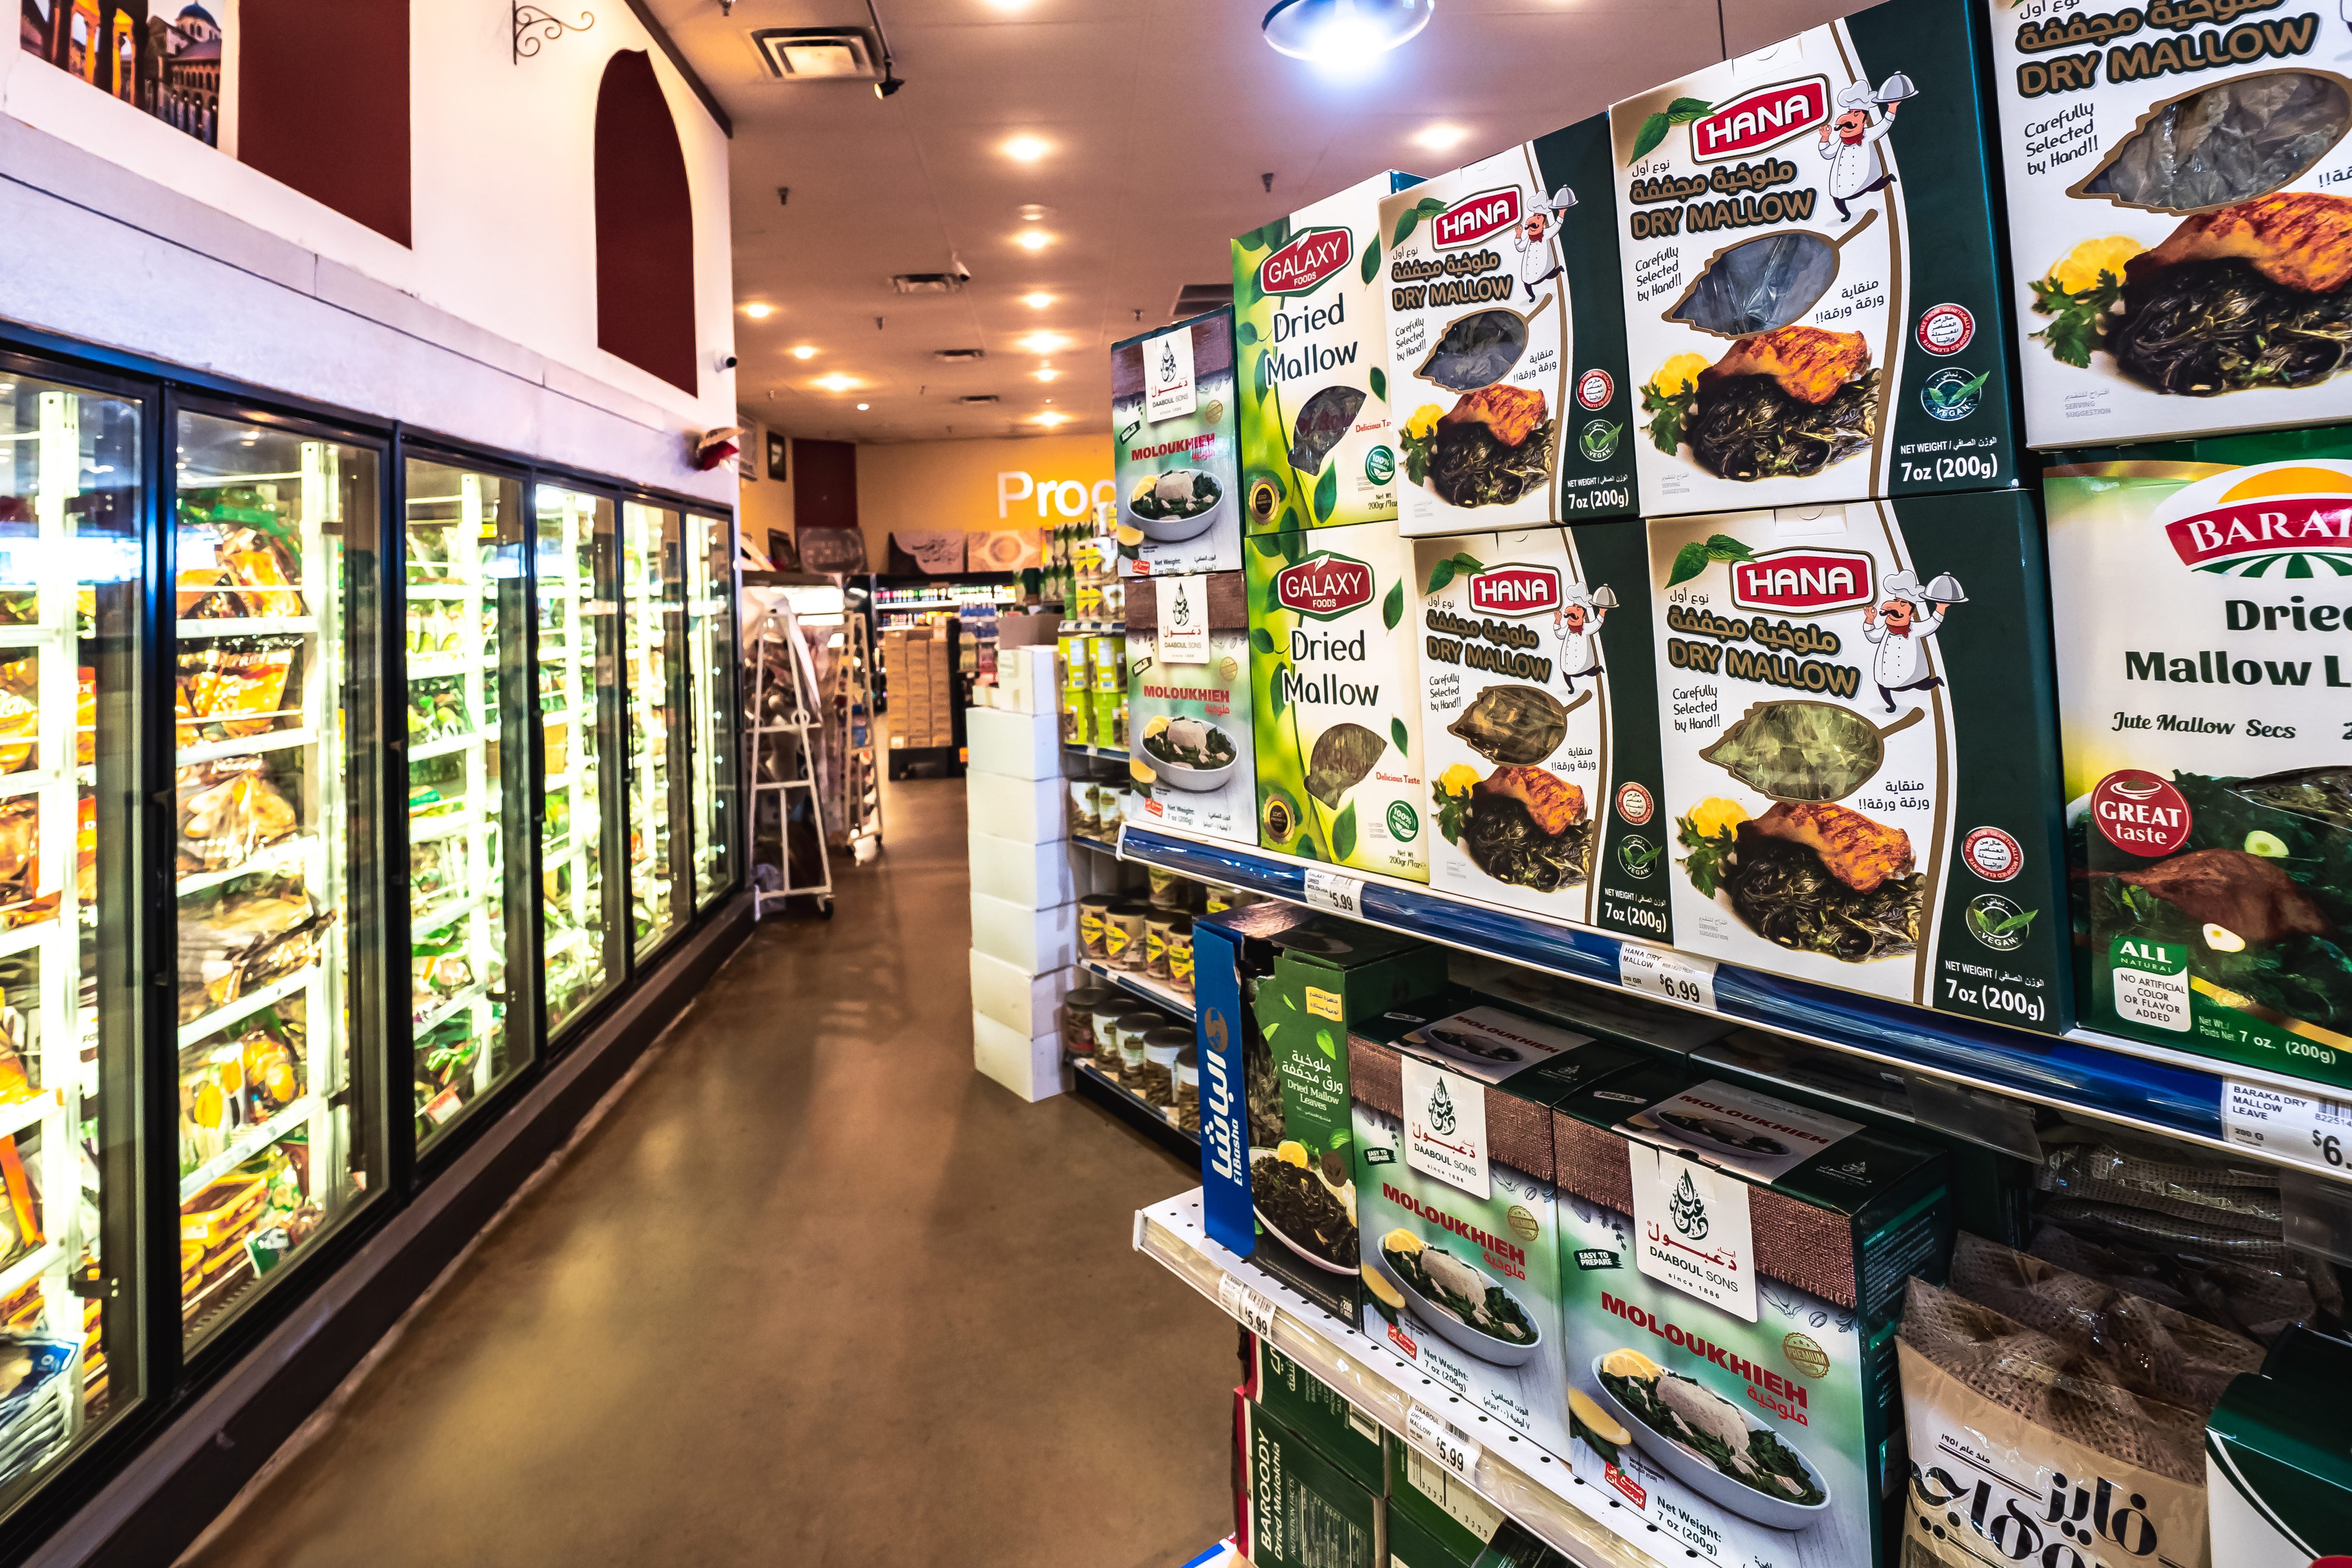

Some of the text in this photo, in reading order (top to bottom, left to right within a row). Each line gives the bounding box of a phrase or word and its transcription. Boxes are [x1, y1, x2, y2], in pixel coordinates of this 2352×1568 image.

[2021, 16, 2313, 96] DRY MALLOW
[1707, 95, 1811, 148] HANA
[2024, 103, 2094, 138] Carefully
[2026, 120, 2094, 157] Selected
[2027, 160, 2046, 175] by
[1630, 159, 1795, 204] ملوخية مجففة
[1442, 199, 1510, 239] HANA
[1631, 190, 1815, 239] DRY MALLOW
[1267, 238, 1343, 285] GALAXY
[1392, 250, 1499, 281] ملوخية مجففة
[1635, 246, 1679, 272] Carefully
[1293, 271, 1317, 286] FOODS
[1637, 260, 1679, 287] Selected
[1393, 275, 1513, 310] DRY MALLOW
[1273, 292, 1345, 343] Dried
[1395, 318, 1424, 337] Carefully
[1396, 330, 1424, 349] Selected
[1266, 341, 1359, 386] Mallow
[2065, 401, 2096, 410] SERVING
[2066, 407, 2111, 418] SUGGESTION
[1356, 423, 1381, 432] Delicious
[1901, 441, 1947, 455] NET WEIGHT
[1373, 454, 1390, 467] 100%
[1936, 454, 1998, 483] (200g)
[1579, 478, 1597, 486] WEIGHT
[1590, 488, 1629, 509] (200g)
[1285, 571, 1361, 598] GALAXY
[1479, 579, 1549, 603] HANA
[1747, 567, 1856, 597] HANA
[1312, 598, 1337, 609] FOODS
[1669, 588, 1709, 605] نوع أول
[1483, 621, 1538, 648] ملوخية
[1669, 606, 1840, 656] ملوخية مجففة
[1291, 629, 1366, 662] Dried
[1427, 637, 1551, 684] DRY MALLOW
[1669, 639, 1859, 699] DRY MALLOW
[2125, 650, 2312, 686] Mallow
[1283, 671, 1379, 706] Mallow
[1430, 674, 1460, 686] Carefully
[1144, 685, 1230, 703] MOLOUKHIEH
[1430, 687, 1460, 699] Selected
[1673, 685, 1718, 701] Carefully
[1431, 700, 1439, 712] by
[1673, 700, 1718, 716] Selected
[1674, 714, 1721, 732] by Hand!!
[2111, 712, 2296, 739] Jute Mallow Secs
[1376, 772, 1420, 785] Delicious Taste
[1885, 780, 1924, 793] منقاية
[1394, 807, 1412, 824] 100%
[1859, 798, 1930, 812] ورقة ورقة!!
[2099, 801, 2182, 828] GREAT
[1972, 830, 1987, 841] FROM
[2115, 822, 2168, 845] taste
[1990, 830, 2019, 860] GENETICALLY
[1968, 858, 1996, 878] ELEMENTS
[1997, 860, 2019, 879] MODIFIED
[1615, 891, 1635, 901] WEIGHT
[1628, 907, 1667, 933] (200g)
[1982, 932, 2016, 946] VEGAN
[1623, 955, 1654, 969] MALLOW
[1625, 947, 1644, 957] HANA
[2119, 941, 2173, 964] ALL
[1946, 960, 1993, 976] NET WEIGHT
[2121, 957, 2173, 973] NATURAL
[1659, 973, 1700, 1003] $6.99
[2121, 973, 2185, 994] NO ARTIFICIAL
[2137, 987, 2169, 1001] COLOR
[1946, 979, 2045, 1022] 7oz (200g)
[2124, 995, 2181, 1014] OR FLAVOR
[2136, 1009, 2170, 1022] ADDED
[2254, 1035, 2336, 1065] oz. (200g)
[1292, 1050, 1331, 1073] ملوخية
[1287, 1079, 1339, 1105] Dried Mallow
[1322, 1076, 1343, 1095] ورق
[1300, 1093, 1327, 1111] Leaves
[2233, 1095, 2283, 1113] MALLOW
[2234, 1086, 2308, 1107] BARAKA DRY
[1205, 1050, 1234, 1178] الباشا
[1678, 1094, 1830, 1146] MOLOUKHIEH
[2233, 1106, 2268, 1120] LEAVE
[1412, 1127, 1476, 1159] دعبول
[1414, 1143, 1477, 1176] DAABOUL SONS
[1427, 1164, 1445, 1175] since
[1382, 1182, 1526, 1267] MOLOUKHIEH
[1647, 1224, 1738, 1272] دعبول
[1581, 1258, 1612, 1266] PREPARE
[1650, 1245, 1739, 1293] DAABOUL SONS
[1668, 1272, 1693, 1288] since
[1601, 1291, 1808, 1409] MOLOUKHIEH
[1787, 1347, 1826, 1365] PREMIUM
[1411, 1412, 1423, 1421] DRY
[1415, 1405, 1439, 1425] DAABOUL
[1409, 1418, 1431, 1436] MALLOW
[1436, 1437, 1463, 1472] $5.99
[1960, 1445, 1974, 1456] عام
[1976, 1452, 1990, 1464] منذ
[1272, 1441, 1281, 1515] Mulokhia
[1620, 1476, 1644, 1496] صنع
[1258, 1426, 1272, 1552] BAROODY
[1657, 1496, 1721, 1543] Net Weight:
[1682, 1527, 1717, 1556] (200g)
